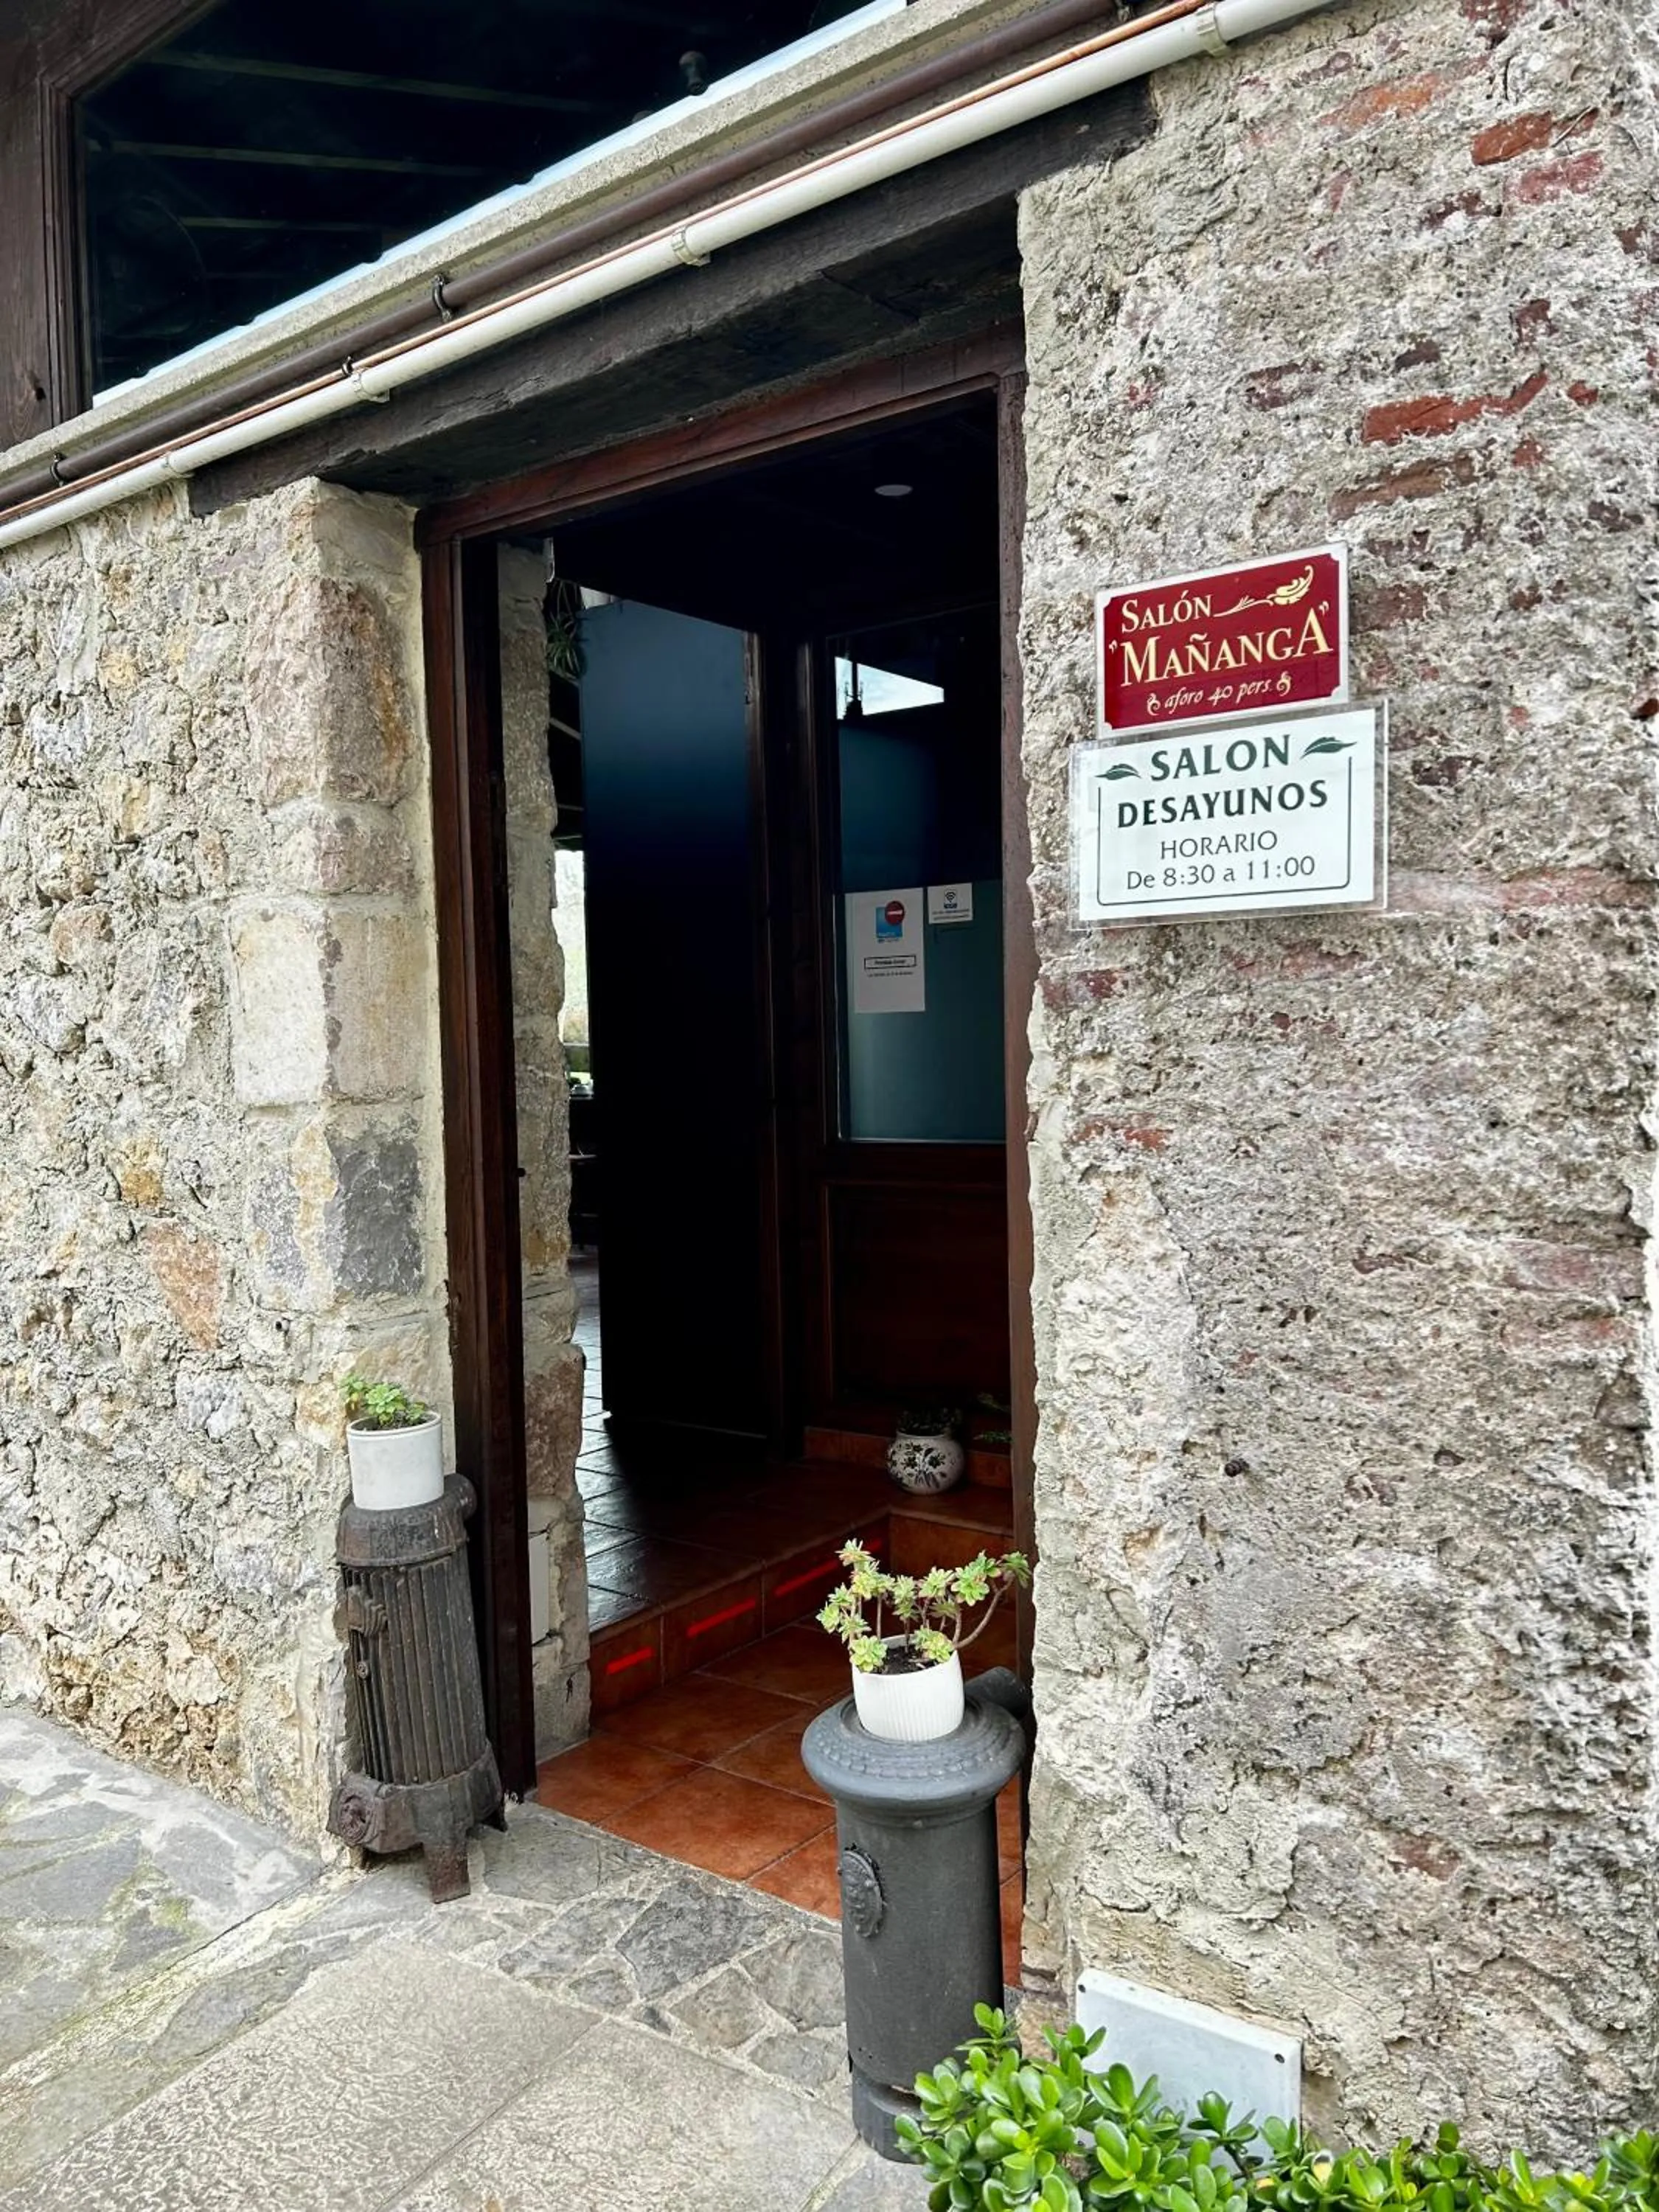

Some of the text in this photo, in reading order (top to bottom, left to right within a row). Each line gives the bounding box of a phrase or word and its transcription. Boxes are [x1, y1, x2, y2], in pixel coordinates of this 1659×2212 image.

[1121, 590, 1213, 633] SALÓN
[1164, 677, 1272, 715] aforo 40 pers.
[1150, 734, 1291, 782] SALON
[1117, 779, 1329, 828] DESAYUNOS
[1160, 830, 1279, 860] HORARIO
[1127, 855, 1316, 890] De 8:30 a 11:00
